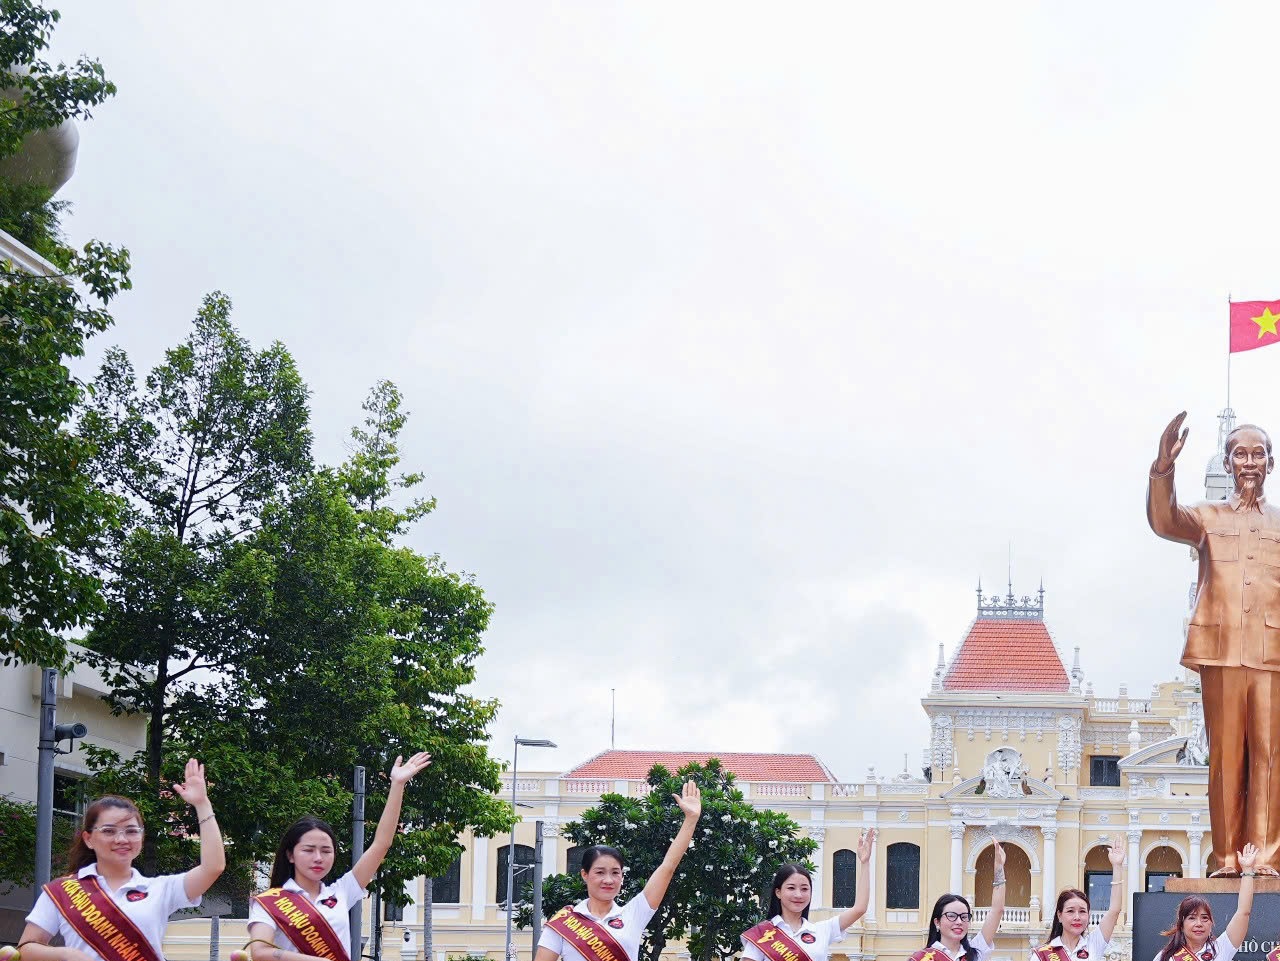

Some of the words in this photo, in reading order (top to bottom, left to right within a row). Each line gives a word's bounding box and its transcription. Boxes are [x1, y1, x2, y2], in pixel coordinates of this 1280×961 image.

[81, 904, 119, 939] DOANH
[274, 897, 297, 917] HOA
[288, 910, 311, 929] HẬU
[301, 925, 330, 957] DOANH
[563, 916, 582, 932] HOA
[771, 940, 788, 956] HOA
